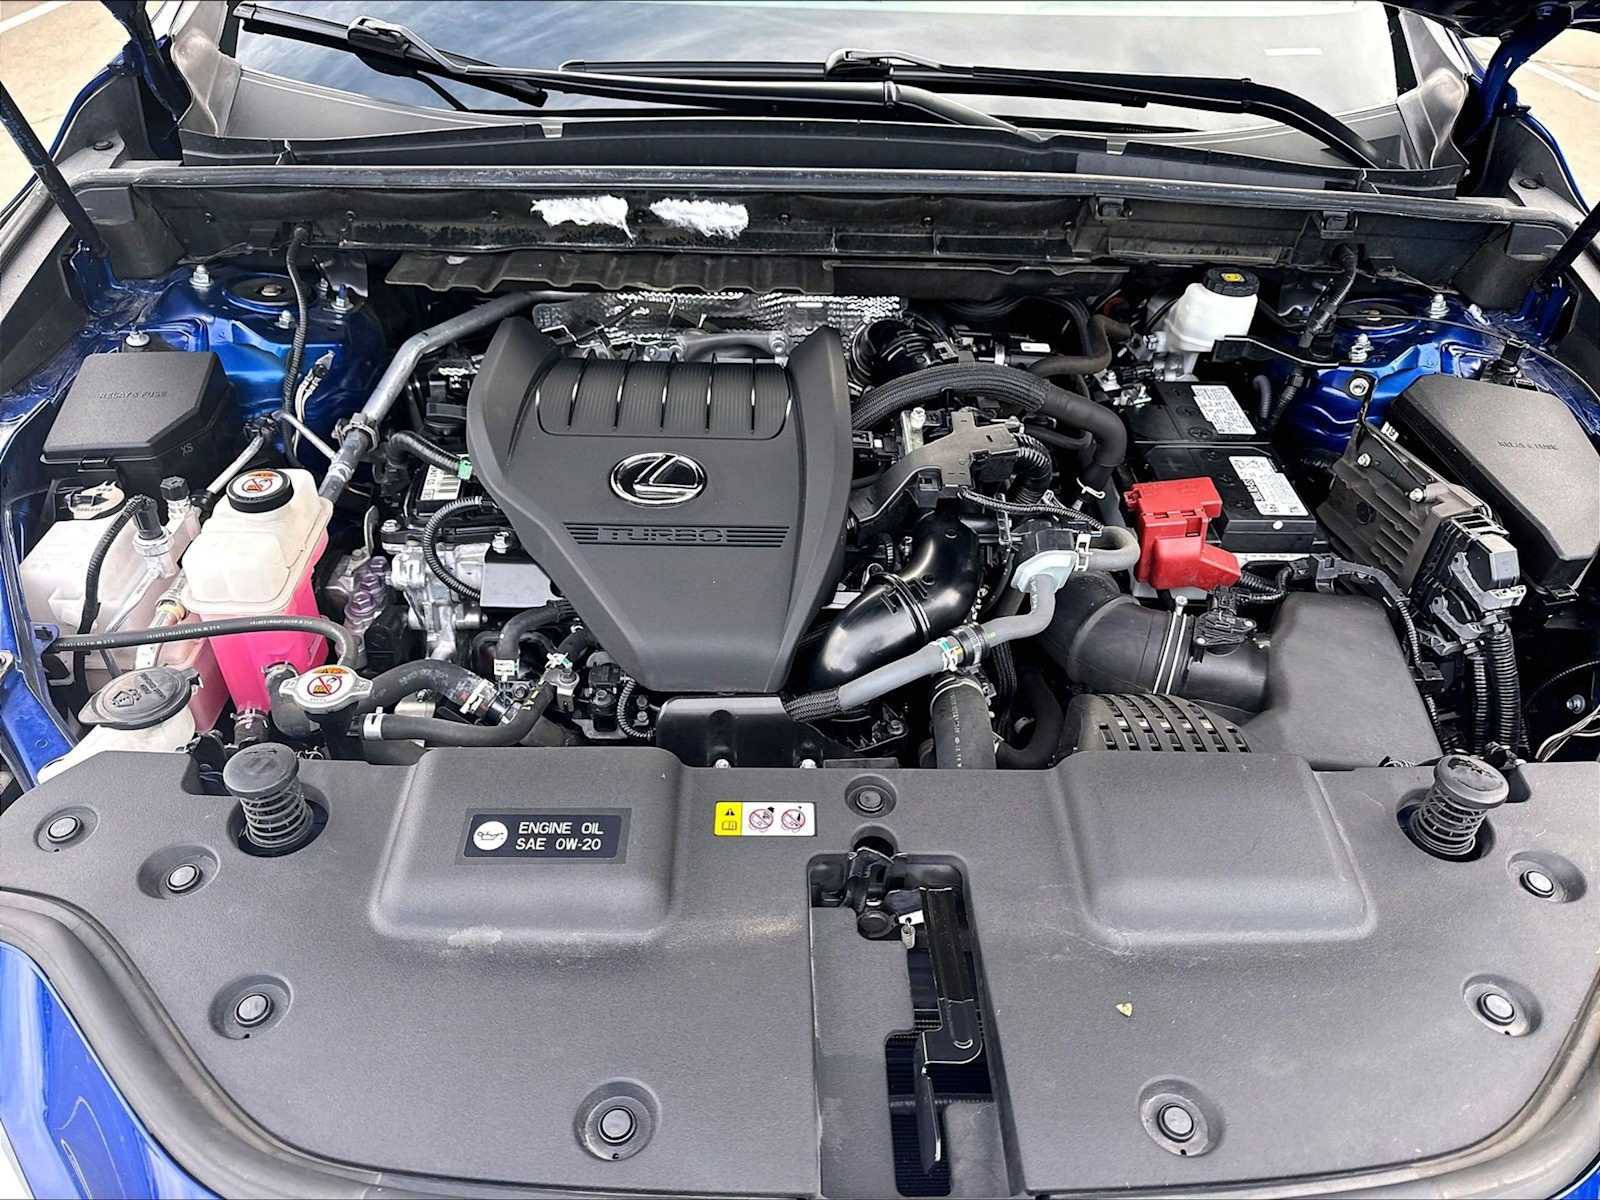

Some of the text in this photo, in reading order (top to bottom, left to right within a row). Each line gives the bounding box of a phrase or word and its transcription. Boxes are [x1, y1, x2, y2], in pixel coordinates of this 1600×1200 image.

[601, 527, 723, 543] TURBO
[518, 822, 604, 834] ENGINE OIL
[515, 838, 601, 850] SAE 0W-20
